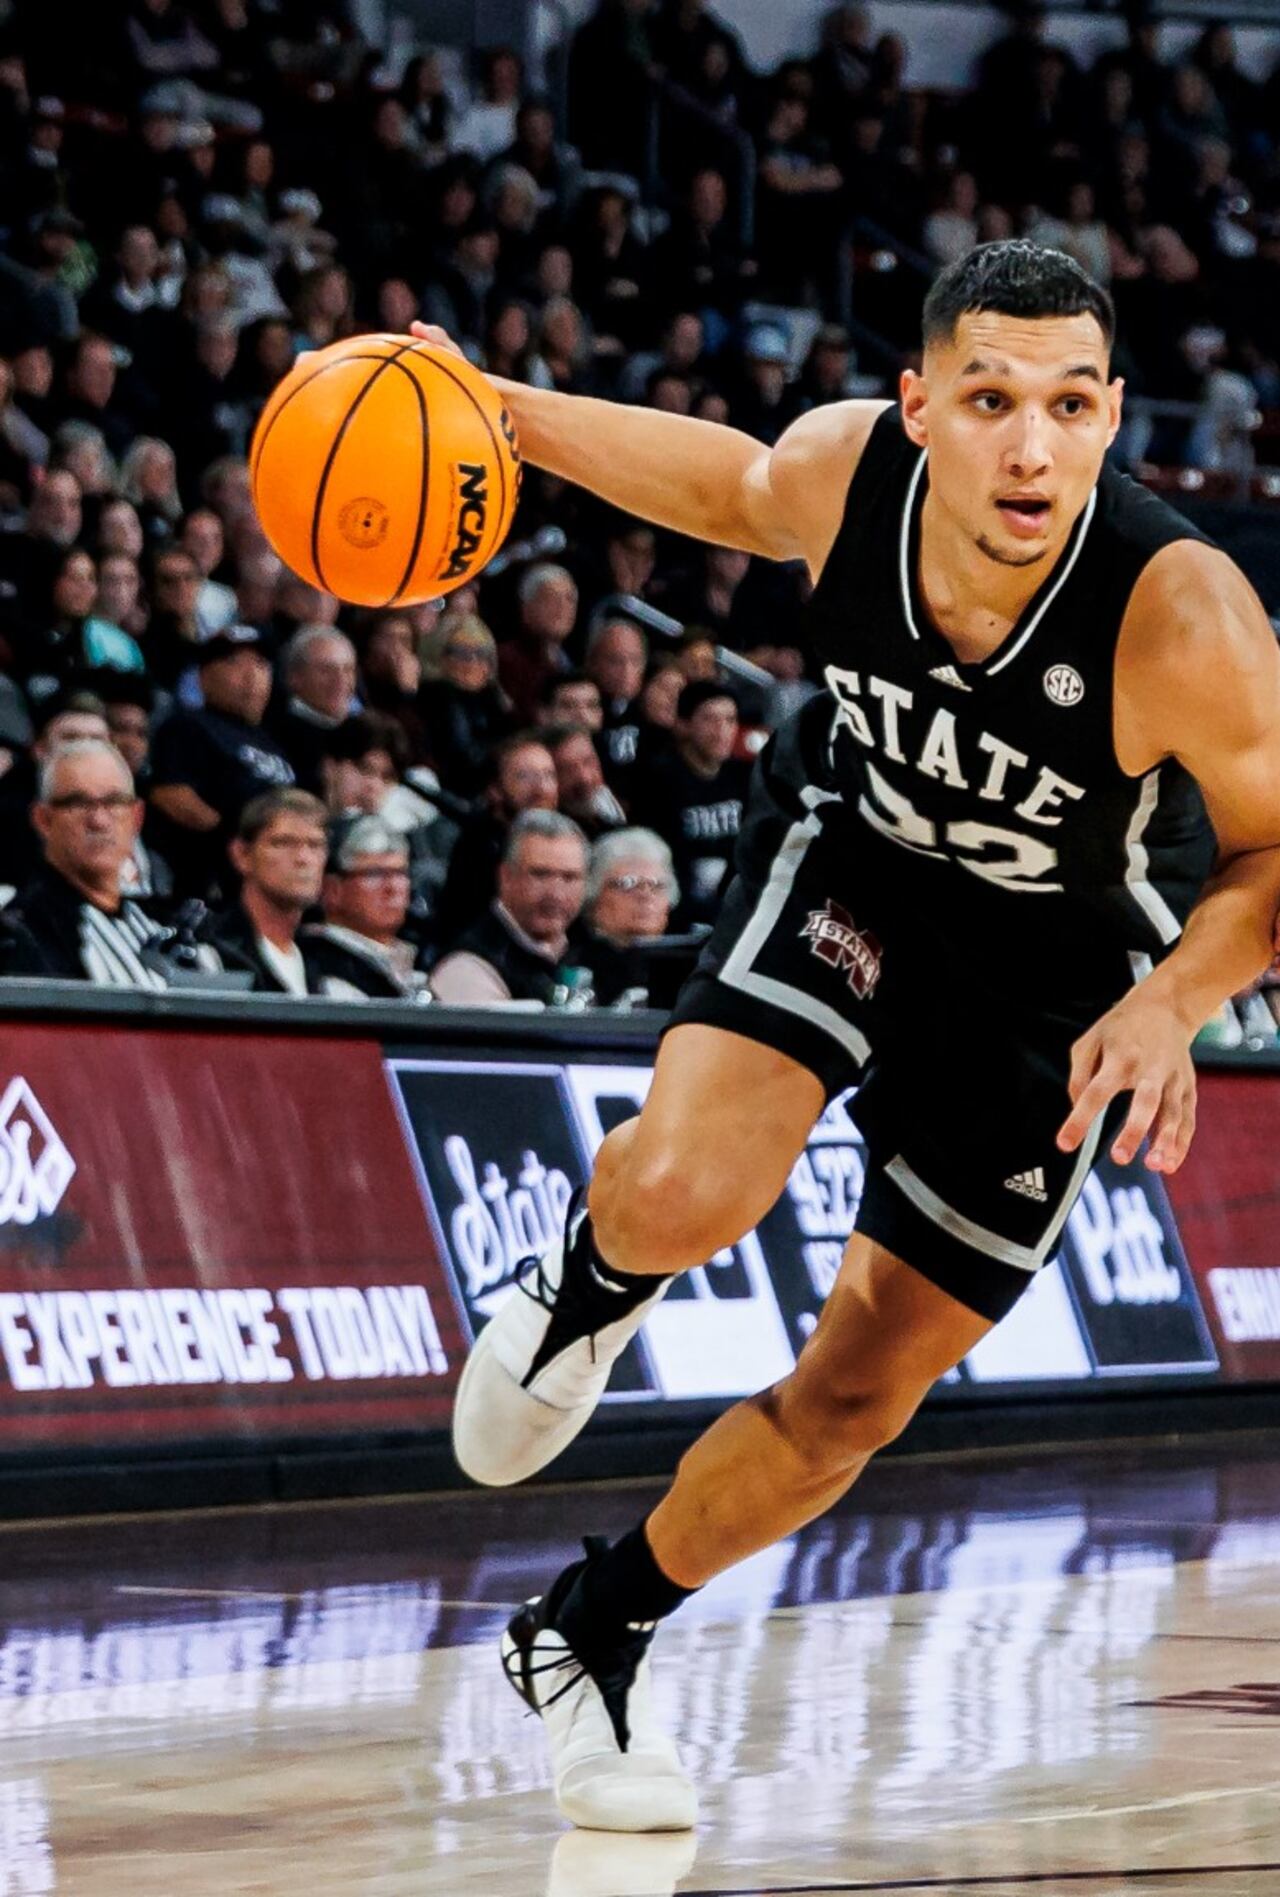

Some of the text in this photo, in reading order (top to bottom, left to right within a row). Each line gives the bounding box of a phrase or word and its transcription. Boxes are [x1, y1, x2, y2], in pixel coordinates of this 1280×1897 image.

[437, 463, 488, 580] NCAA
[1048, 668, 1082, 701] SEC
[824, 664, 1086, 826] STATE
[0, 1285, 449, 1391] EXPERIENCE TODAY!
